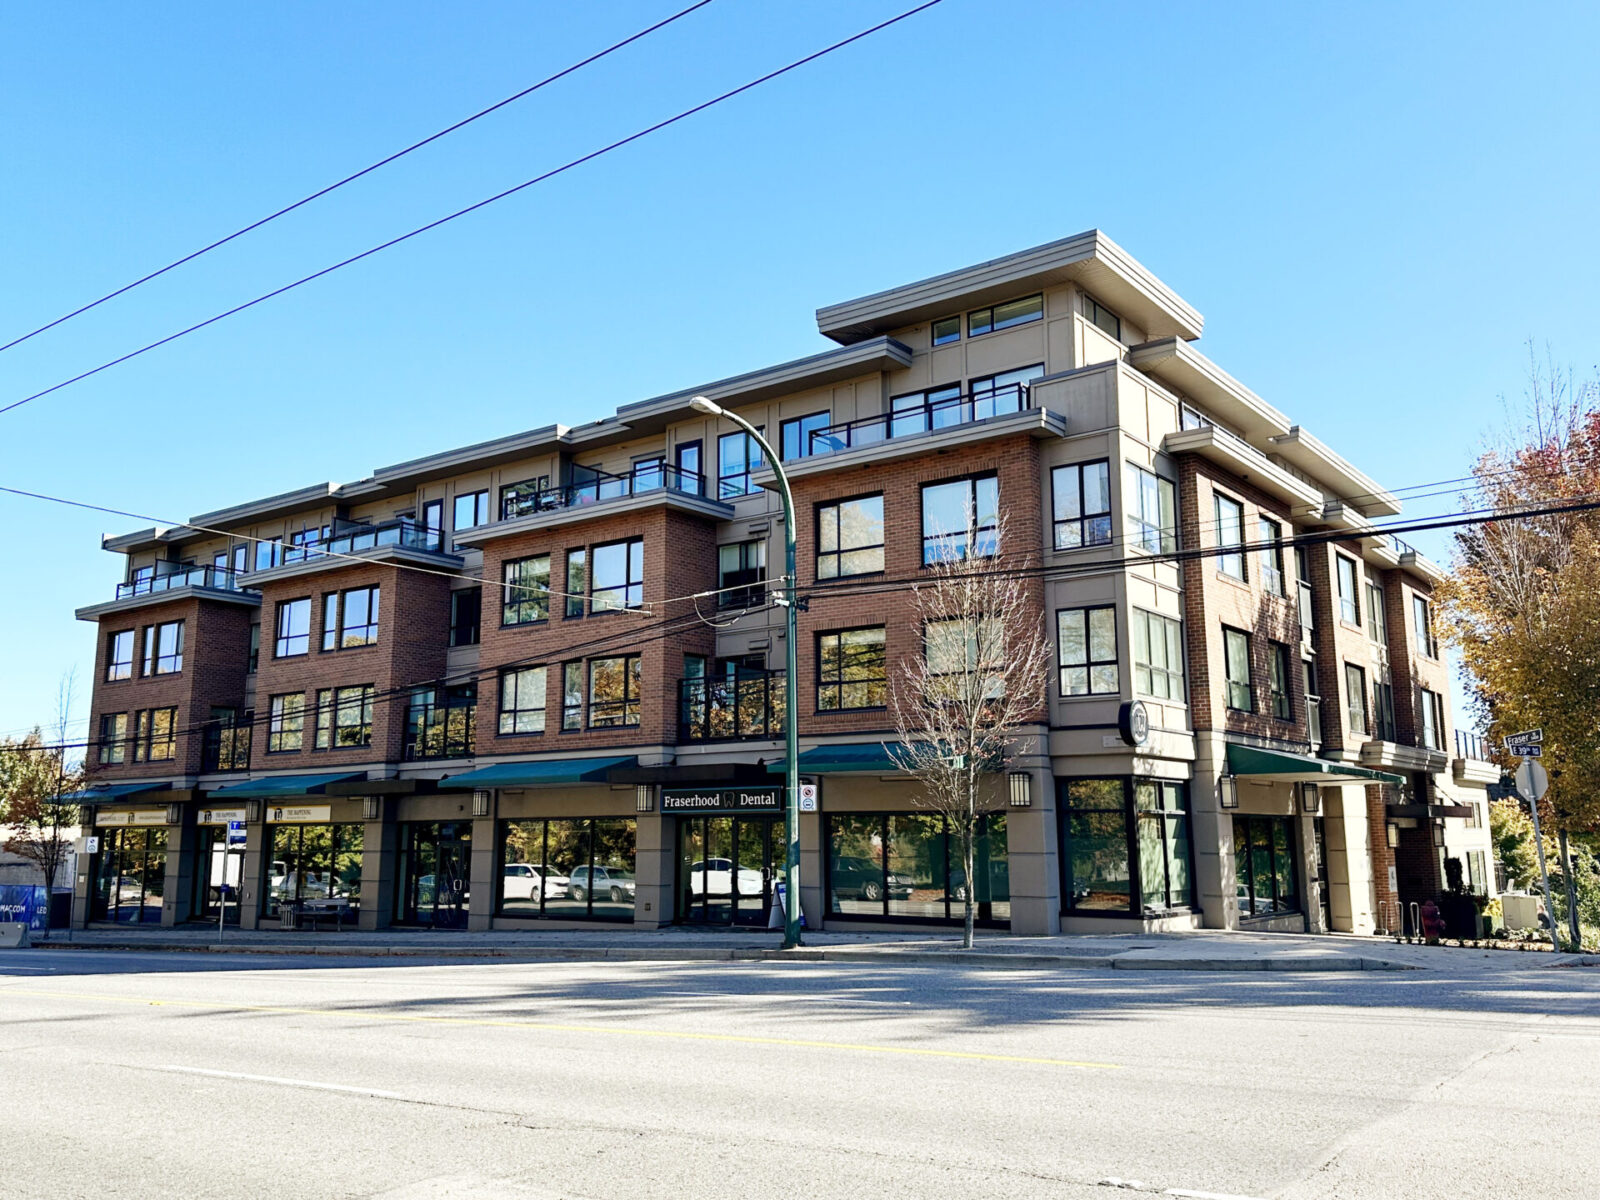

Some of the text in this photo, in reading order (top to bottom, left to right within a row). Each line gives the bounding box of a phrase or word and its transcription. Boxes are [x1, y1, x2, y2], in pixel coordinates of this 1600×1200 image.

[1507, 734, 1529, 745] Fraser
[1513, 746, 1518, 755] E
[664, 792, 776, 807] Fraserhood Dental
